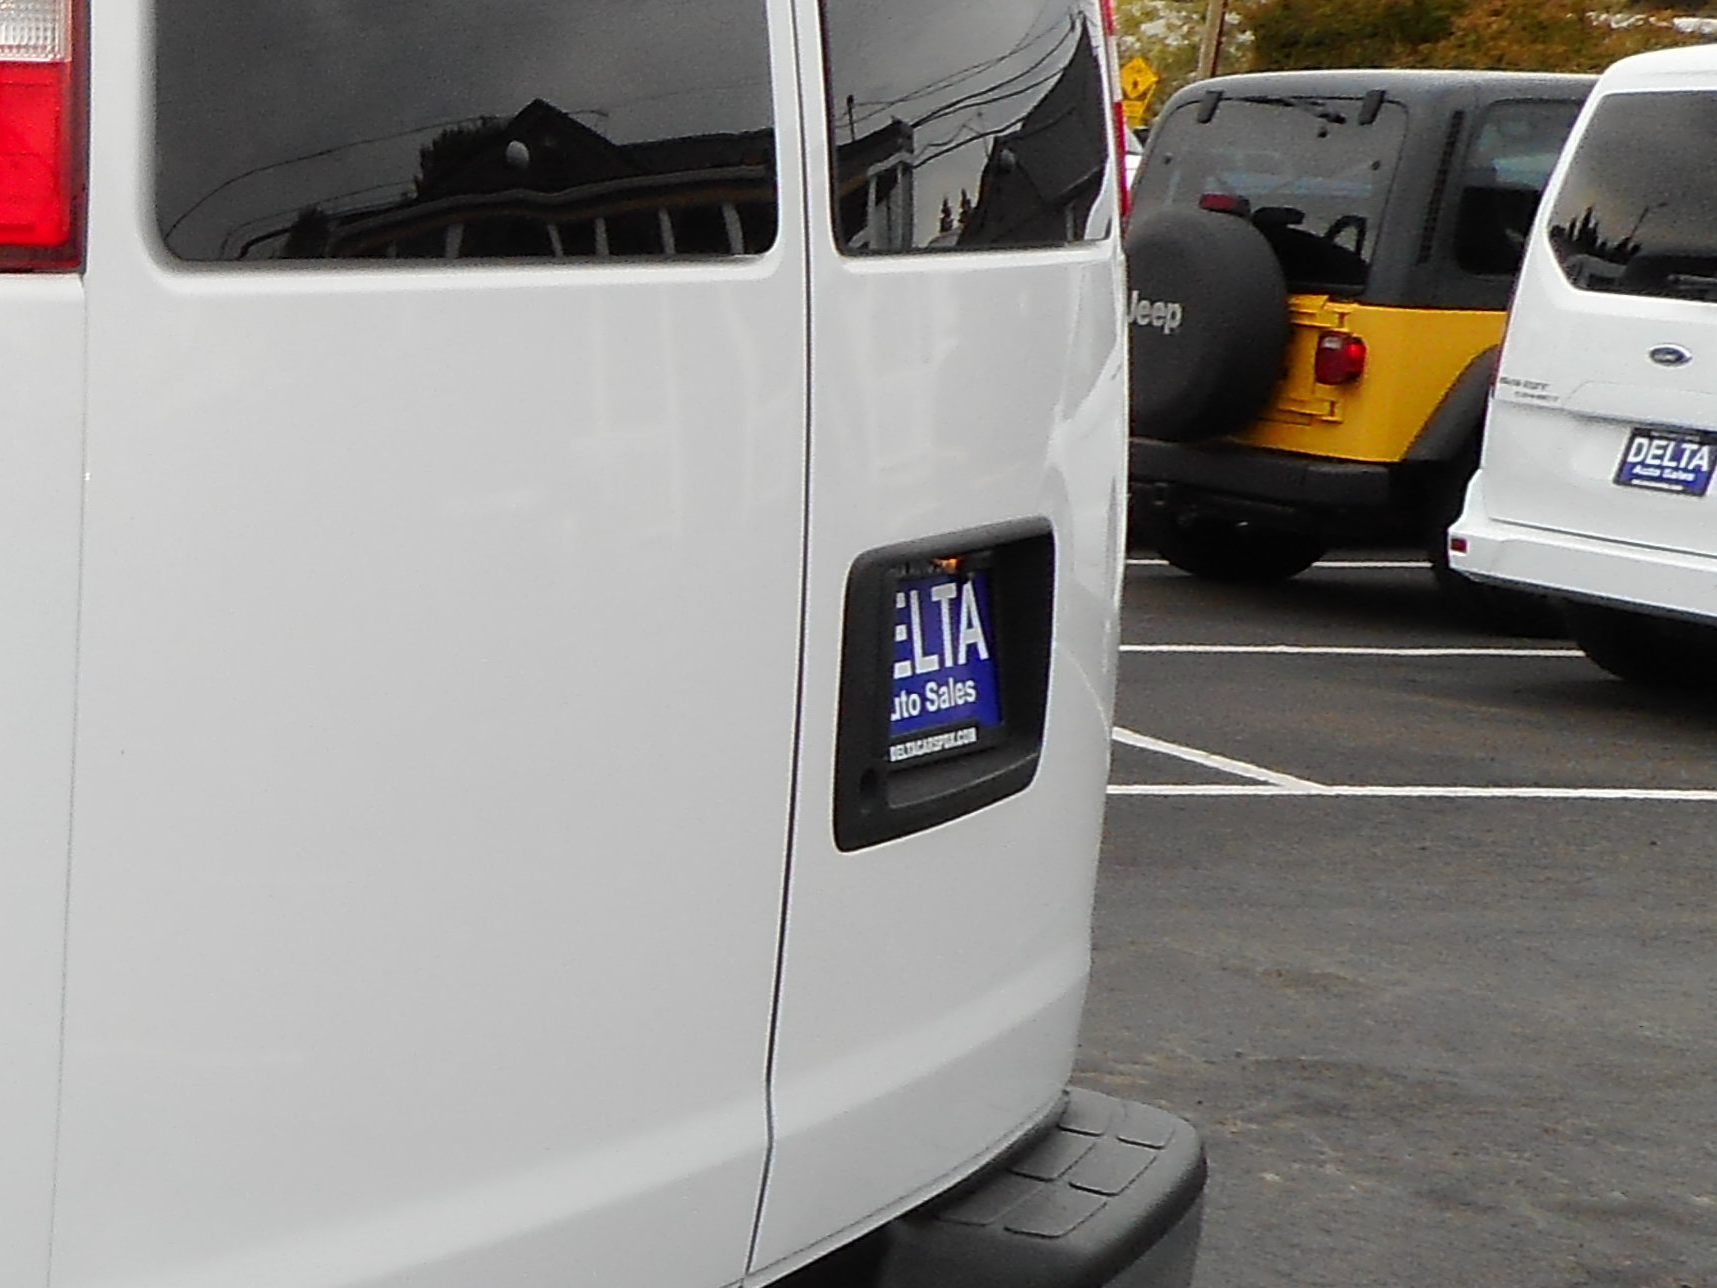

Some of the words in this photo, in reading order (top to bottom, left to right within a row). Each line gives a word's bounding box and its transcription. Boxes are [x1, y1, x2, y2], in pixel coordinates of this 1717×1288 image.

[1127, 290, 1182, 334] Jeep
[1626, 436, 1709, 472] DELTA
[925, 676, 977, 712] Sales
